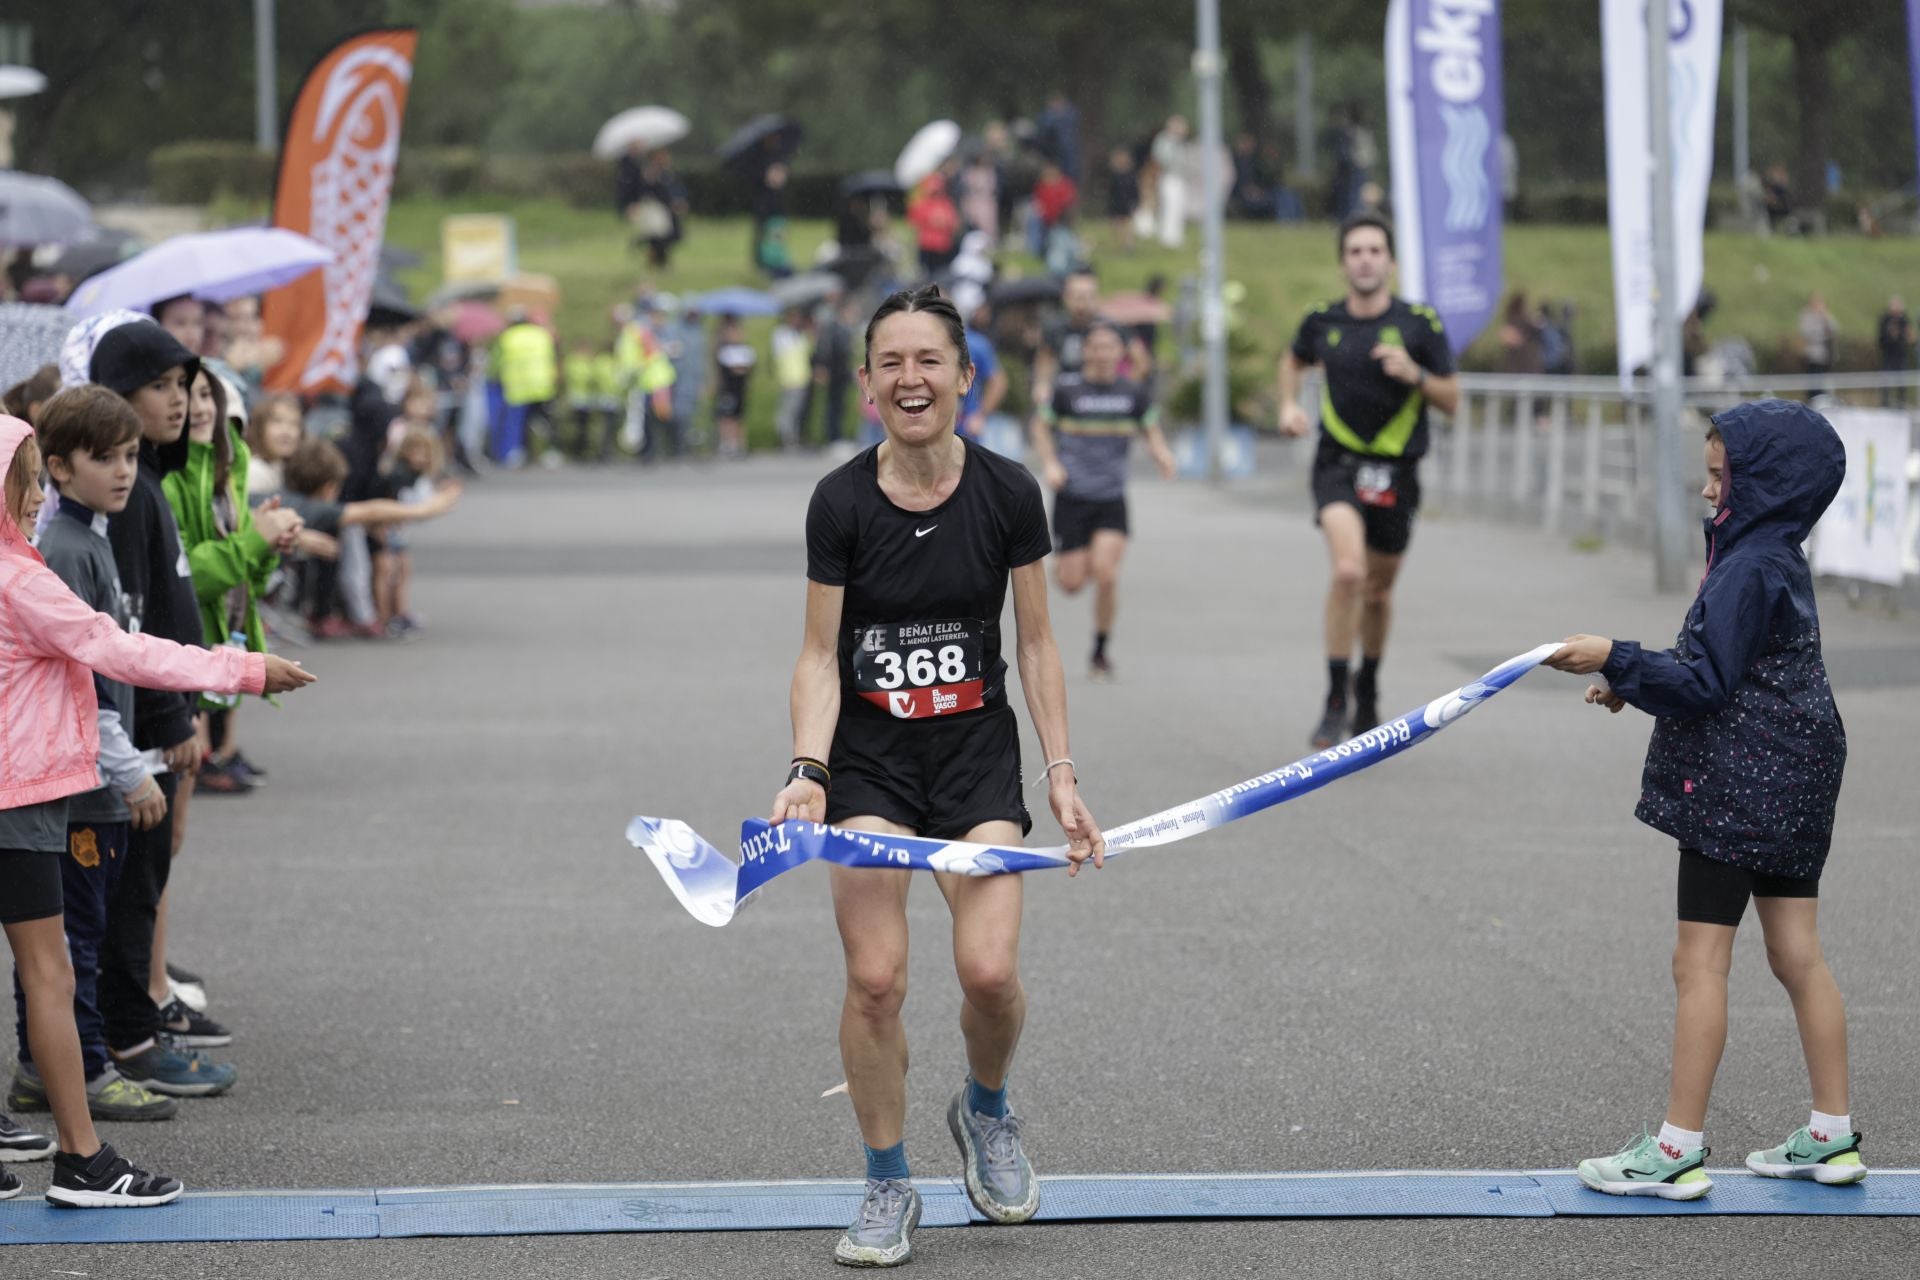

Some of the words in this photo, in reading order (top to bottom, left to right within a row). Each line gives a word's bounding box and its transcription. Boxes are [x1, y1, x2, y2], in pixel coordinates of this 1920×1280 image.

[899, 623, 933, 638] BEÑAT
[935, 622, 962, 635] ELZO
[899, 638, 907, 646] X.
[907, 635, 930, 646] MENDI
[930, 631, 969, 644] LASTERKETA
[873, 645, 967, 690] 368
[932, 689, 941, 697] EL
[932, 693, 958, 703] DIARIO
[933, 701, 957, 710] VASCO
[1320, 718, 1411, 762] Bidasoa
[1659, 1141, 1684, 1160] adid
